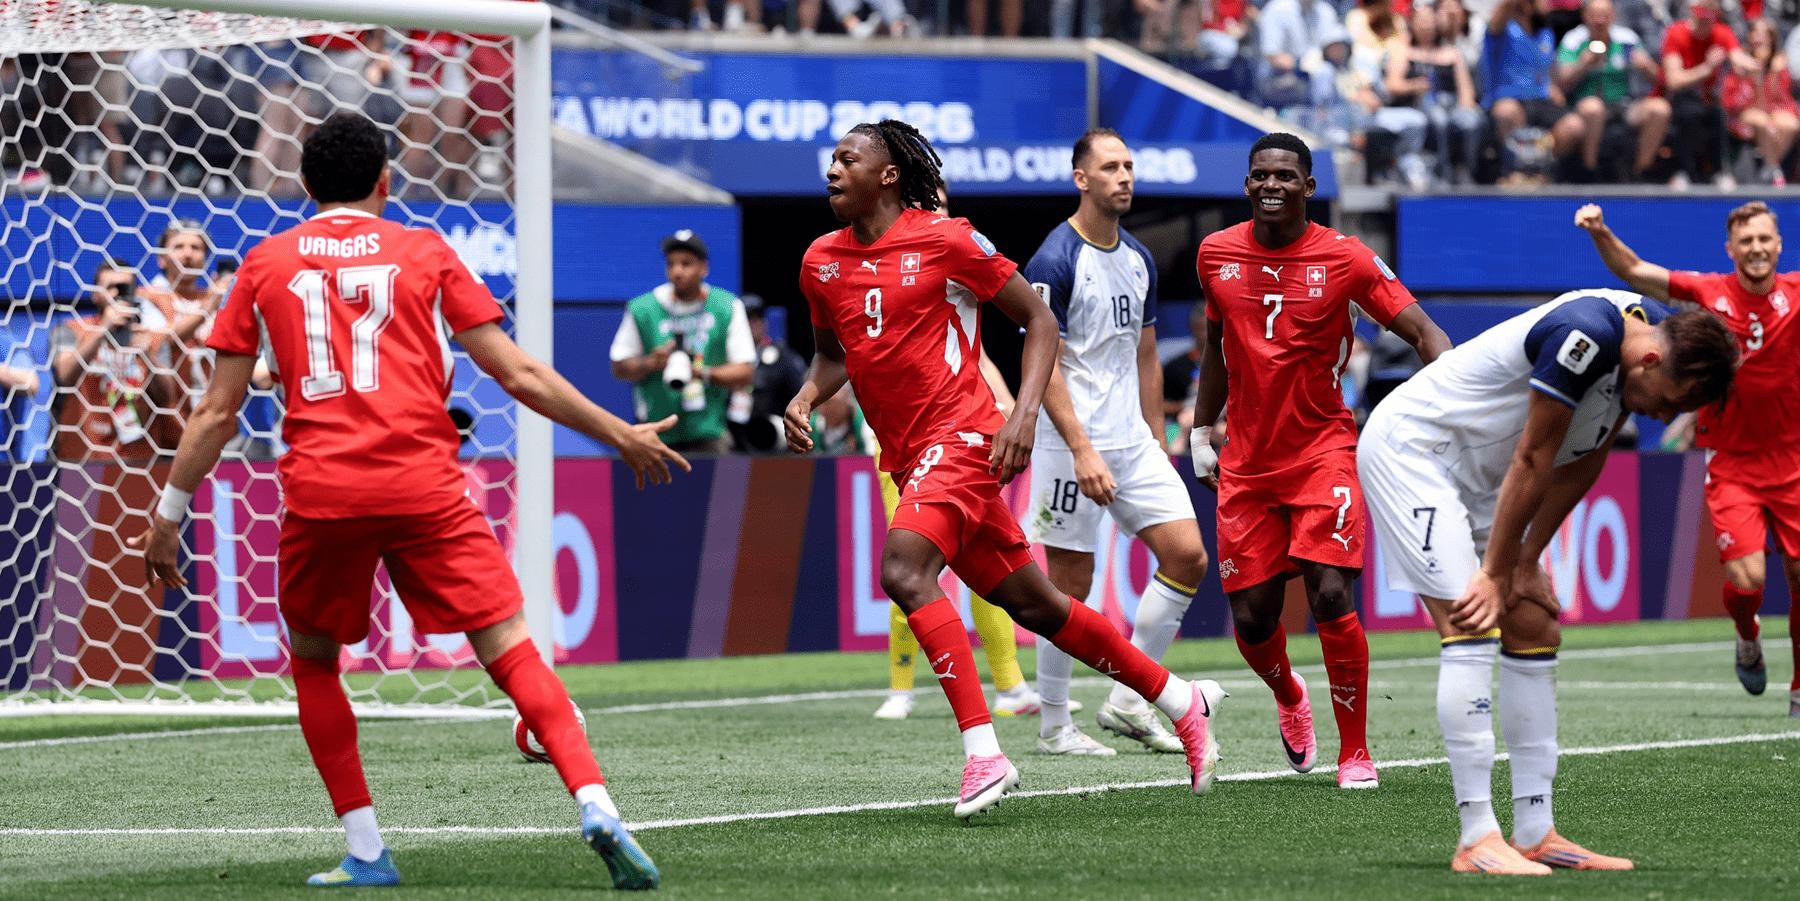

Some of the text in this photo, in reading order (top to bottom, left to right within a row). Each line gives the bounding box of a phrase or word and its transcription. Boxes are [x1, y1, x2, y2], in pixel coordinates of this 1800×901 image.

[592, 97, 743, 139] WORLD
[745, 98, 829, 141] CUP
[298, 232, 380, 257] VARGAS
[287, 264, 401, 401] 17
[864, 288, 883, 338] 9
[1111, 294, 1130, 328] 18
[1263, 294, 1284, 339] 7
[1746, 321, 1764, 350] 3
[914, 444, 944, 477] 9
[1050, 478, 1079, 513] 18
[1332, 486, 1352, 529] 7
[1412, 507, 1437, 551] 7
